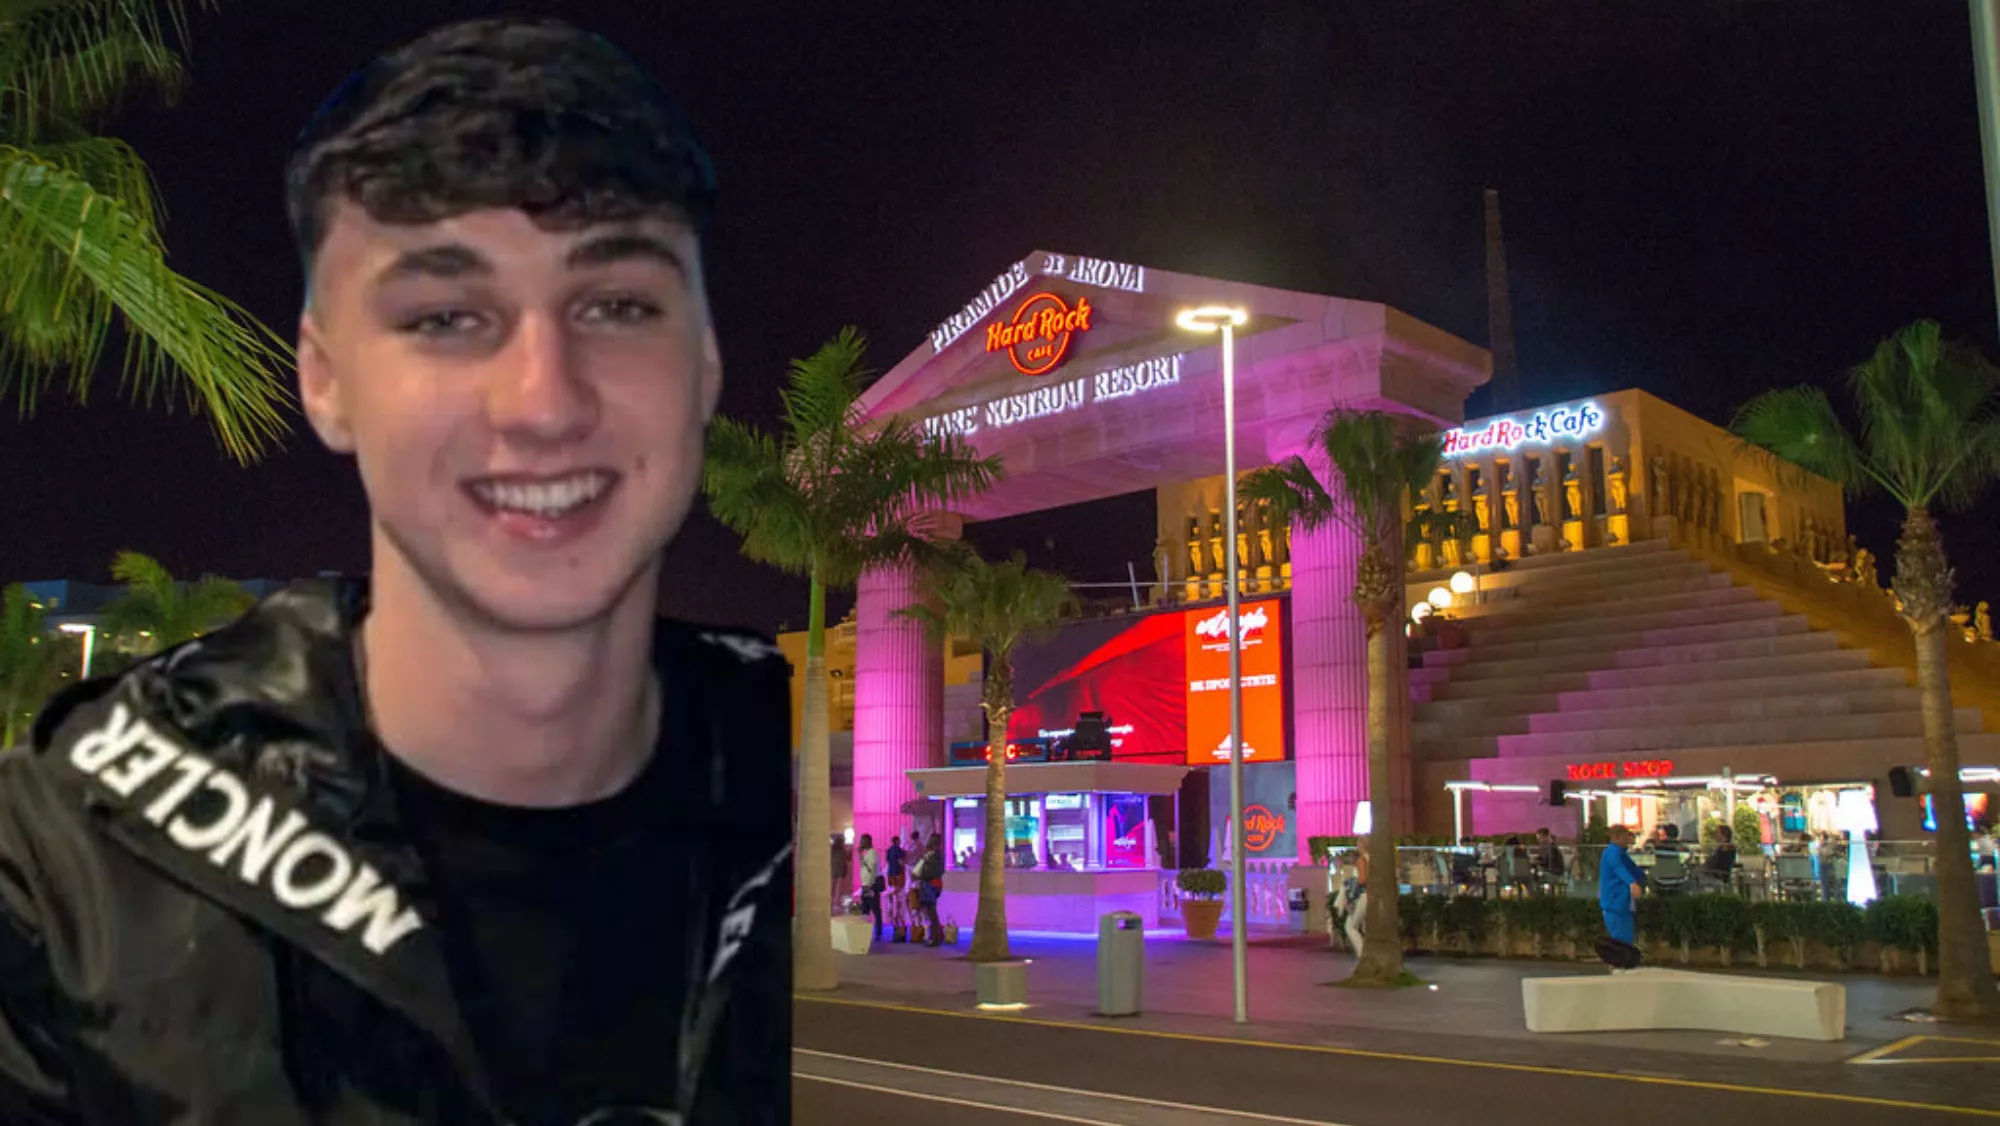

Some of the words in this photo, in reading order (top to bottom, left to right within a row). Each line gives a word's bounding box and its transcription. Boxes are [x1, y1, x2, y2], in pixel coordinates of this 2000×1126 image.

[931, 260, 1029, 354] PIRAMIDE
[1066, 256, 1144, 293] ARONA
[986, 311, 1039, 352] Hard
[1039, 296, 1092, 342] Rock
[985, 377, 1084, 429] NOSTRUM
[1093, 352, 1184, 404] RESORT
[1442, 424, 1495, 455] Hard
[1497, 413, 1547, 449] Rock
[1550, 405, 1600, 434] Cafe
[1566, 762, 1617, 781] ROCK
[1622, 759, 1674, 777] SHOP
[70, 705, 423, 955] MONCLER
